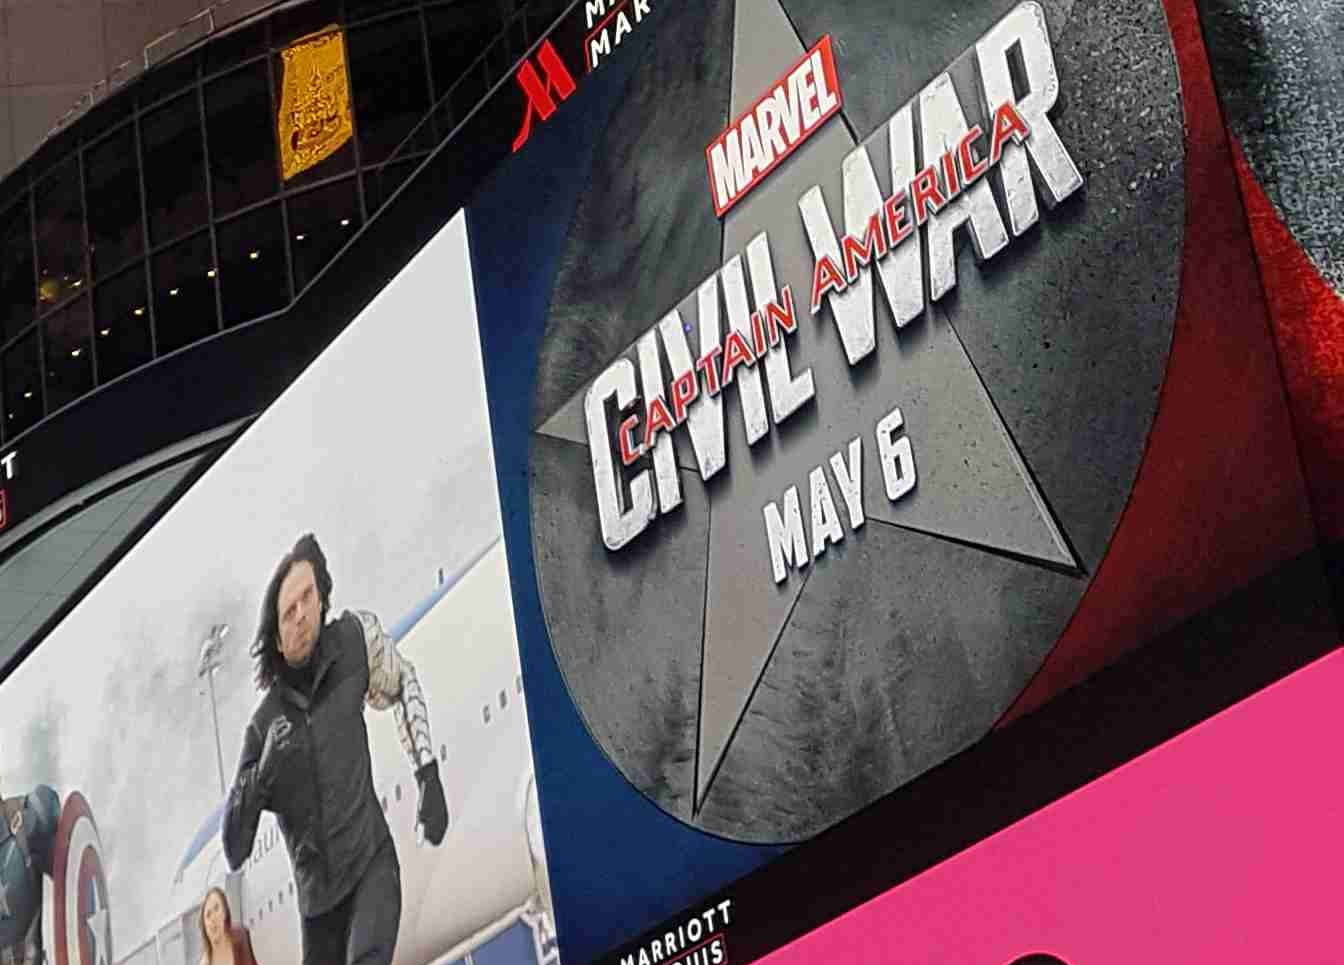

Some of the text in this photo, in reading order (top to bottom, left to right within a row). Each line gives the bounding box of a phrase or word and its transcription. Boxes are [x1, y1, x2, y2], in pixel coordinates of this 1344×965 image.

[710, 45, 841, 208] MARVEL
[583, 0, 1085, 551] CIVIL WAR
[618, 100, 1033, 467] CAPTAIN AMERICA
[762, 406, 918, 586] MAY 6
